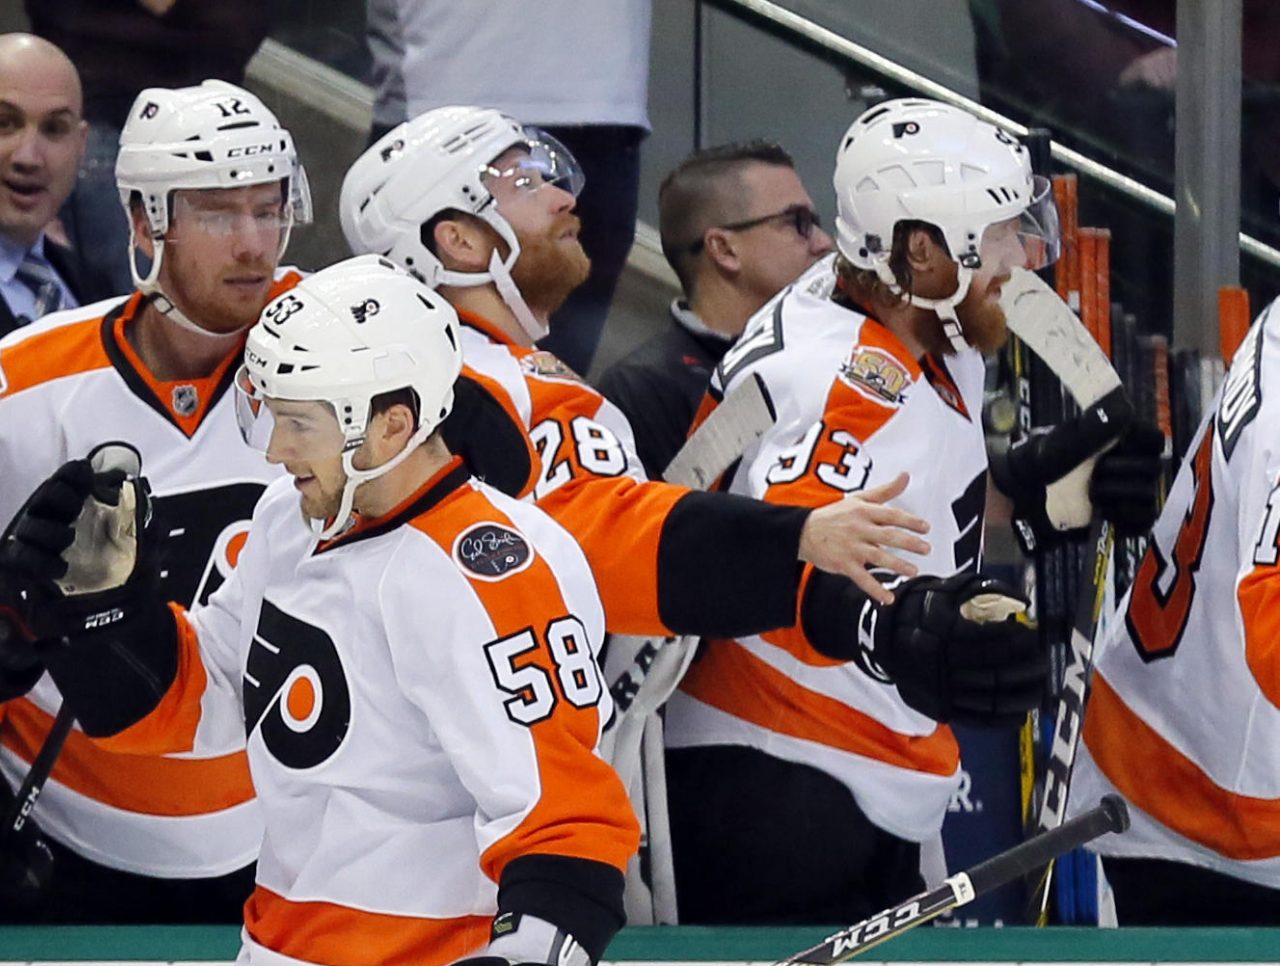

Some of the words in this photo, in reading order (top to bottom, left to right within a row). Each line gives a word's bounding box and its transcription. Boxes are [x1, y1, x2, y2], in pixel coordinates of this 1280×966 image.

[214, 98, 251, 118] 12
[227, 144, 273, 158] CCM
[265, 294, 304, 326] 53
[246, 347, 268, 369] CM
[528, 414, 629, 501] 28
[482, 614, 603, 728] 58
[1038, 626, 1094, 830] CCM
[13, 785, 40, 832] CCM
[832, 901, 920, 958] CCM
